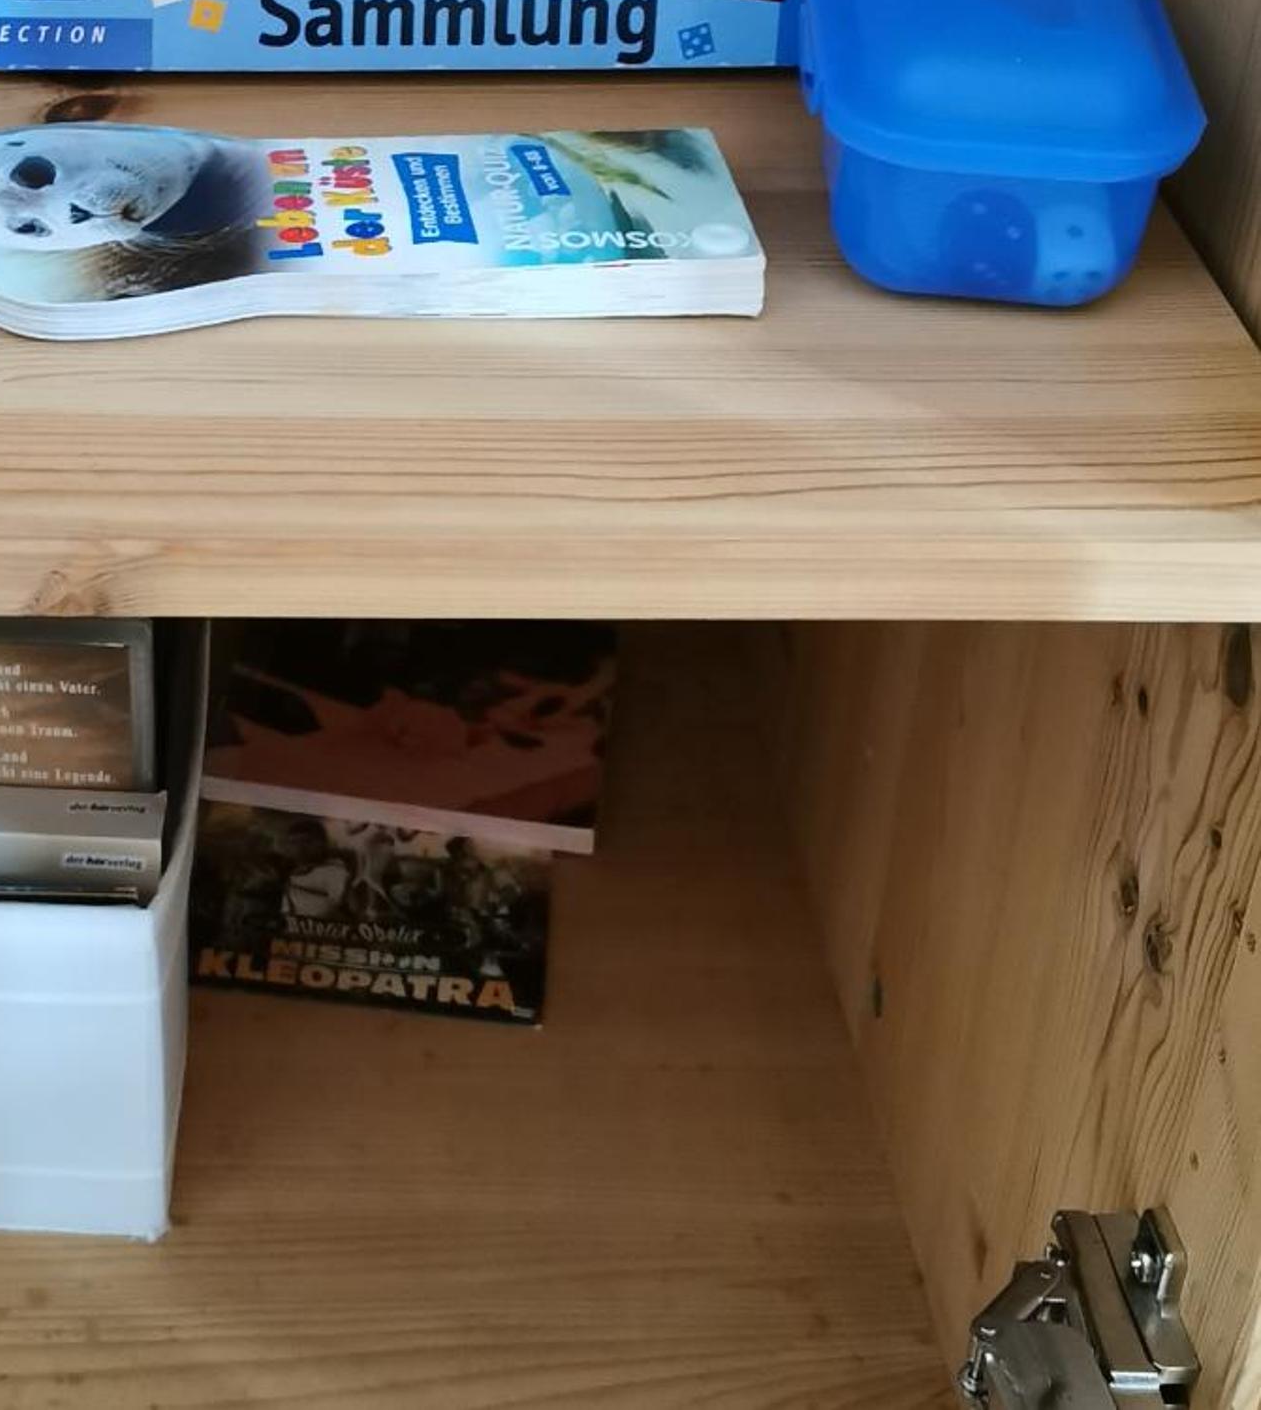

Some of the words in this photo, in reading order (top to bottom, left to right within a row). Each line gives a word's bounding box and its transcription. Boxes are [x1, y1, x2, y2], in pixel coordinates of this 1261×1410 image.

[403, 155, 426, 176] und
[432, 164, 464, 226] Bestimmen
[255, 180, 325, 261] Leben
[332, 207, 394, 259] der
[412, 177, 441, 239] Entdecken
[197, 945, 516, 1011] KLEOPATRA
